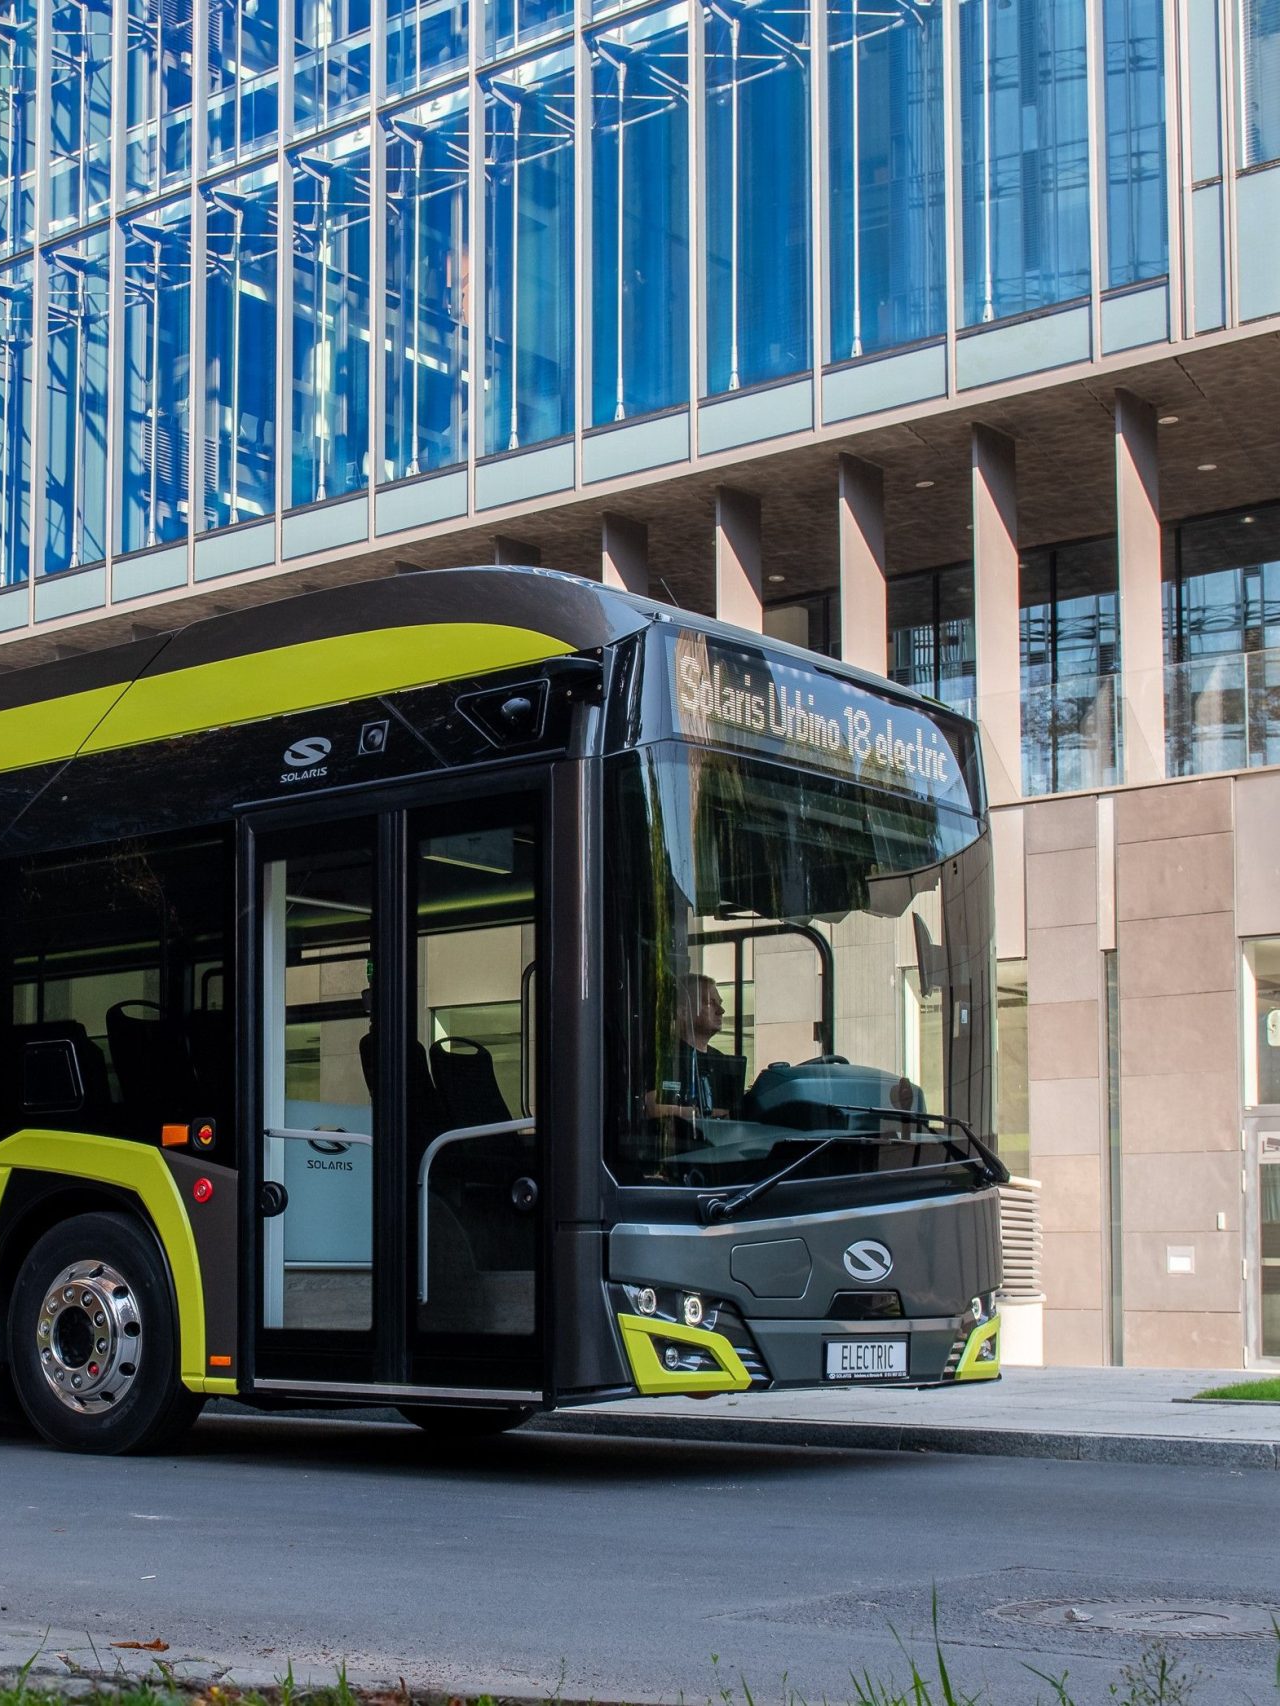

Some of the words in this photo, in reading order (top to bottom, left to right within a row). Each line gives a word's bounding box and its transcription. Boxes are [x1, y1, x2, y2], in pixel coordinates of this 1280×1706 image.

[679, 655, 765, 729] Solaris
[769, 681, 840, 751] Urbino
[844, 706, 871, 759] 18
[877, 719, 948, 782] electric
[280, 766, 328, 783] SOLARIS
[307, 1160, 353, 1171] SOLARIS
[841, 1345, 893, 1370] ELECTRIC
